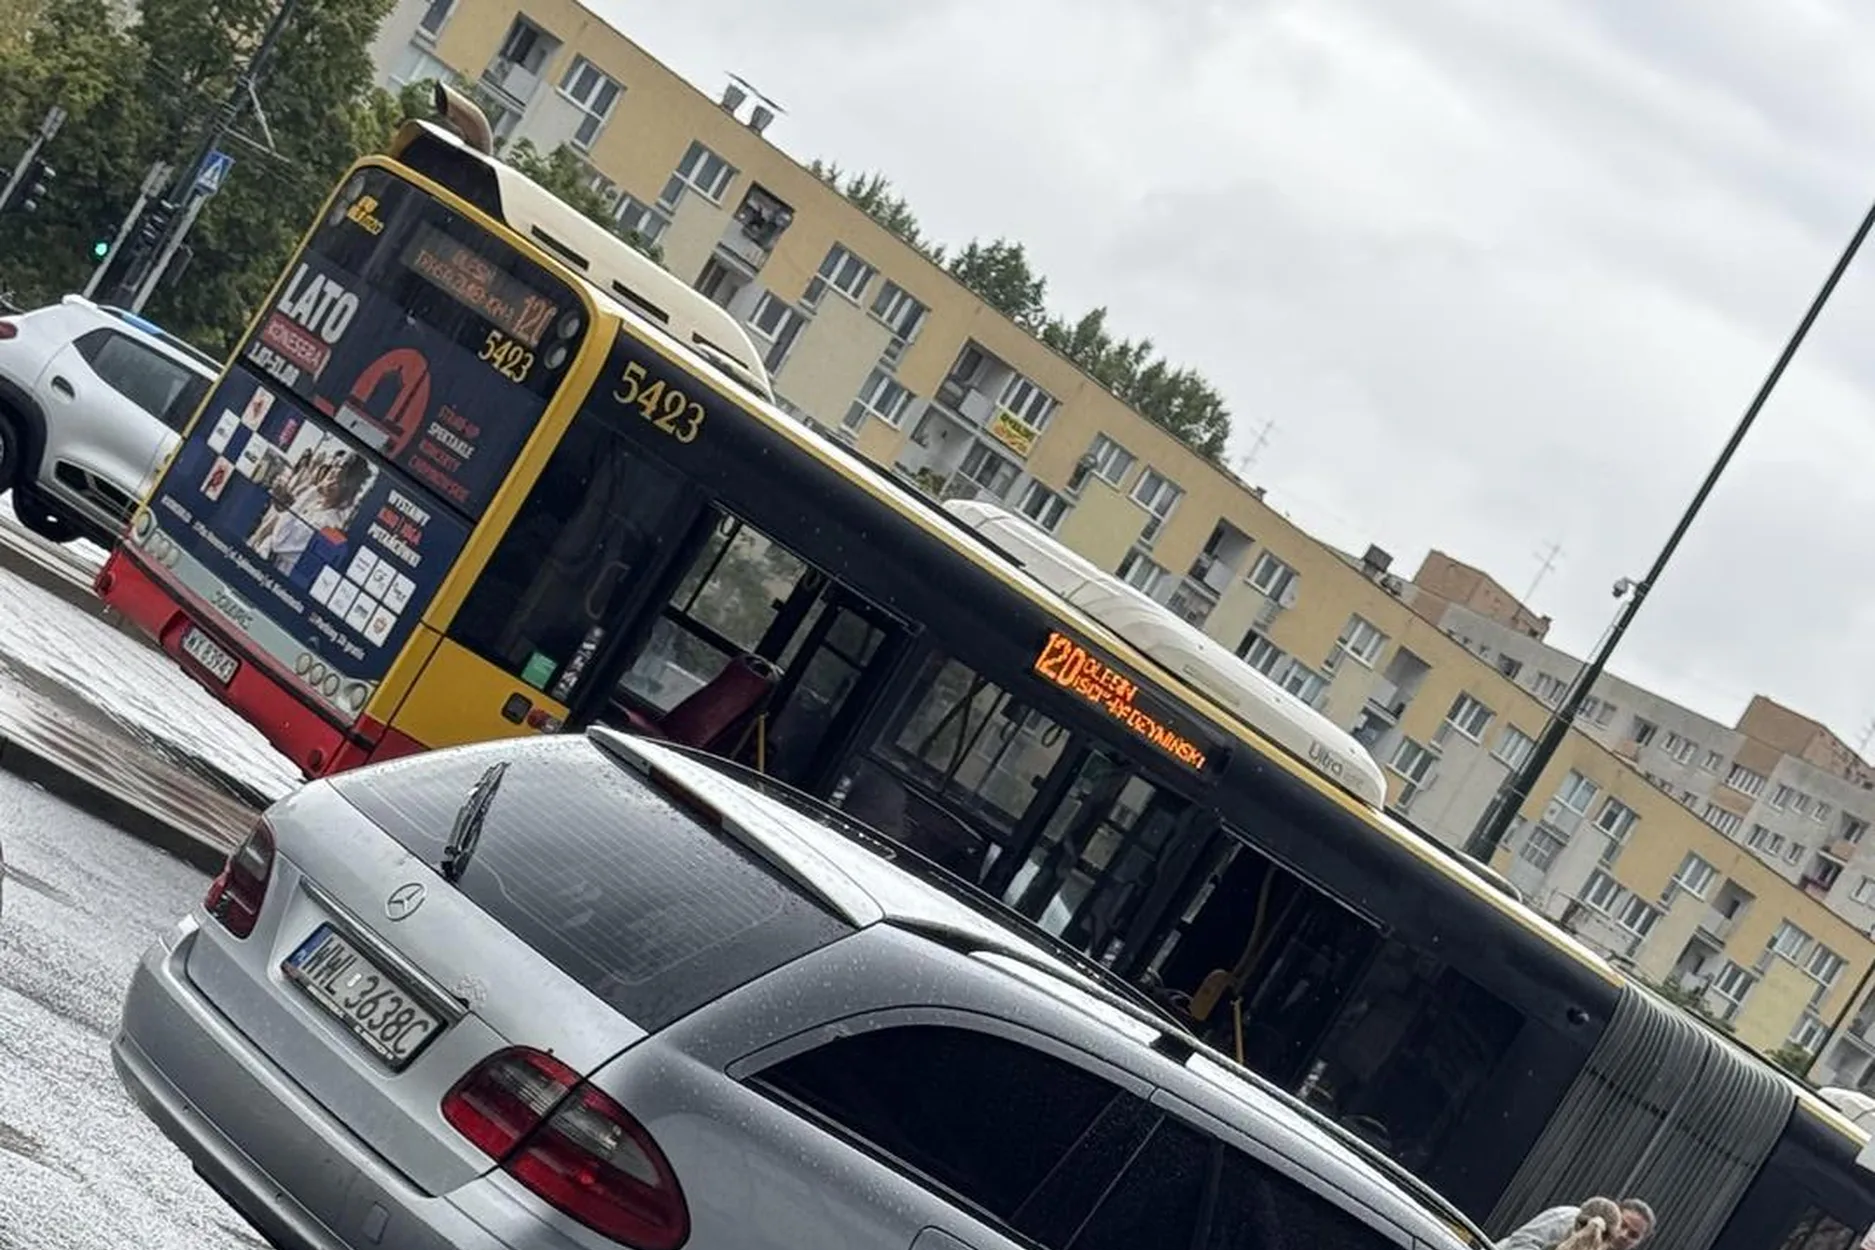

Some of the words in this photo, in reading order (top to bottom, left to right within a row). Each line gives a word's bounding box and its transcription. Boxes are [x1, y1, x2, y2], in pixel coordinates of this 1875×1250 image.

[276, 262, 361, 346] LATO
[513, 293, 556, 345] 120
[478, 332, 535, 383] 5423
[611, 358, 706, 444] 5423
[427, 421, 476, 460] SPEKTAKLE
[1035, 631, 1090, 689] 120
[1081, 657, 1138, 702] OLESIN
[1309, 740, 1344, 776] Ultra
[302, 937, 358, 995] WWL
[344, 973, 430, 1055] 3638C
